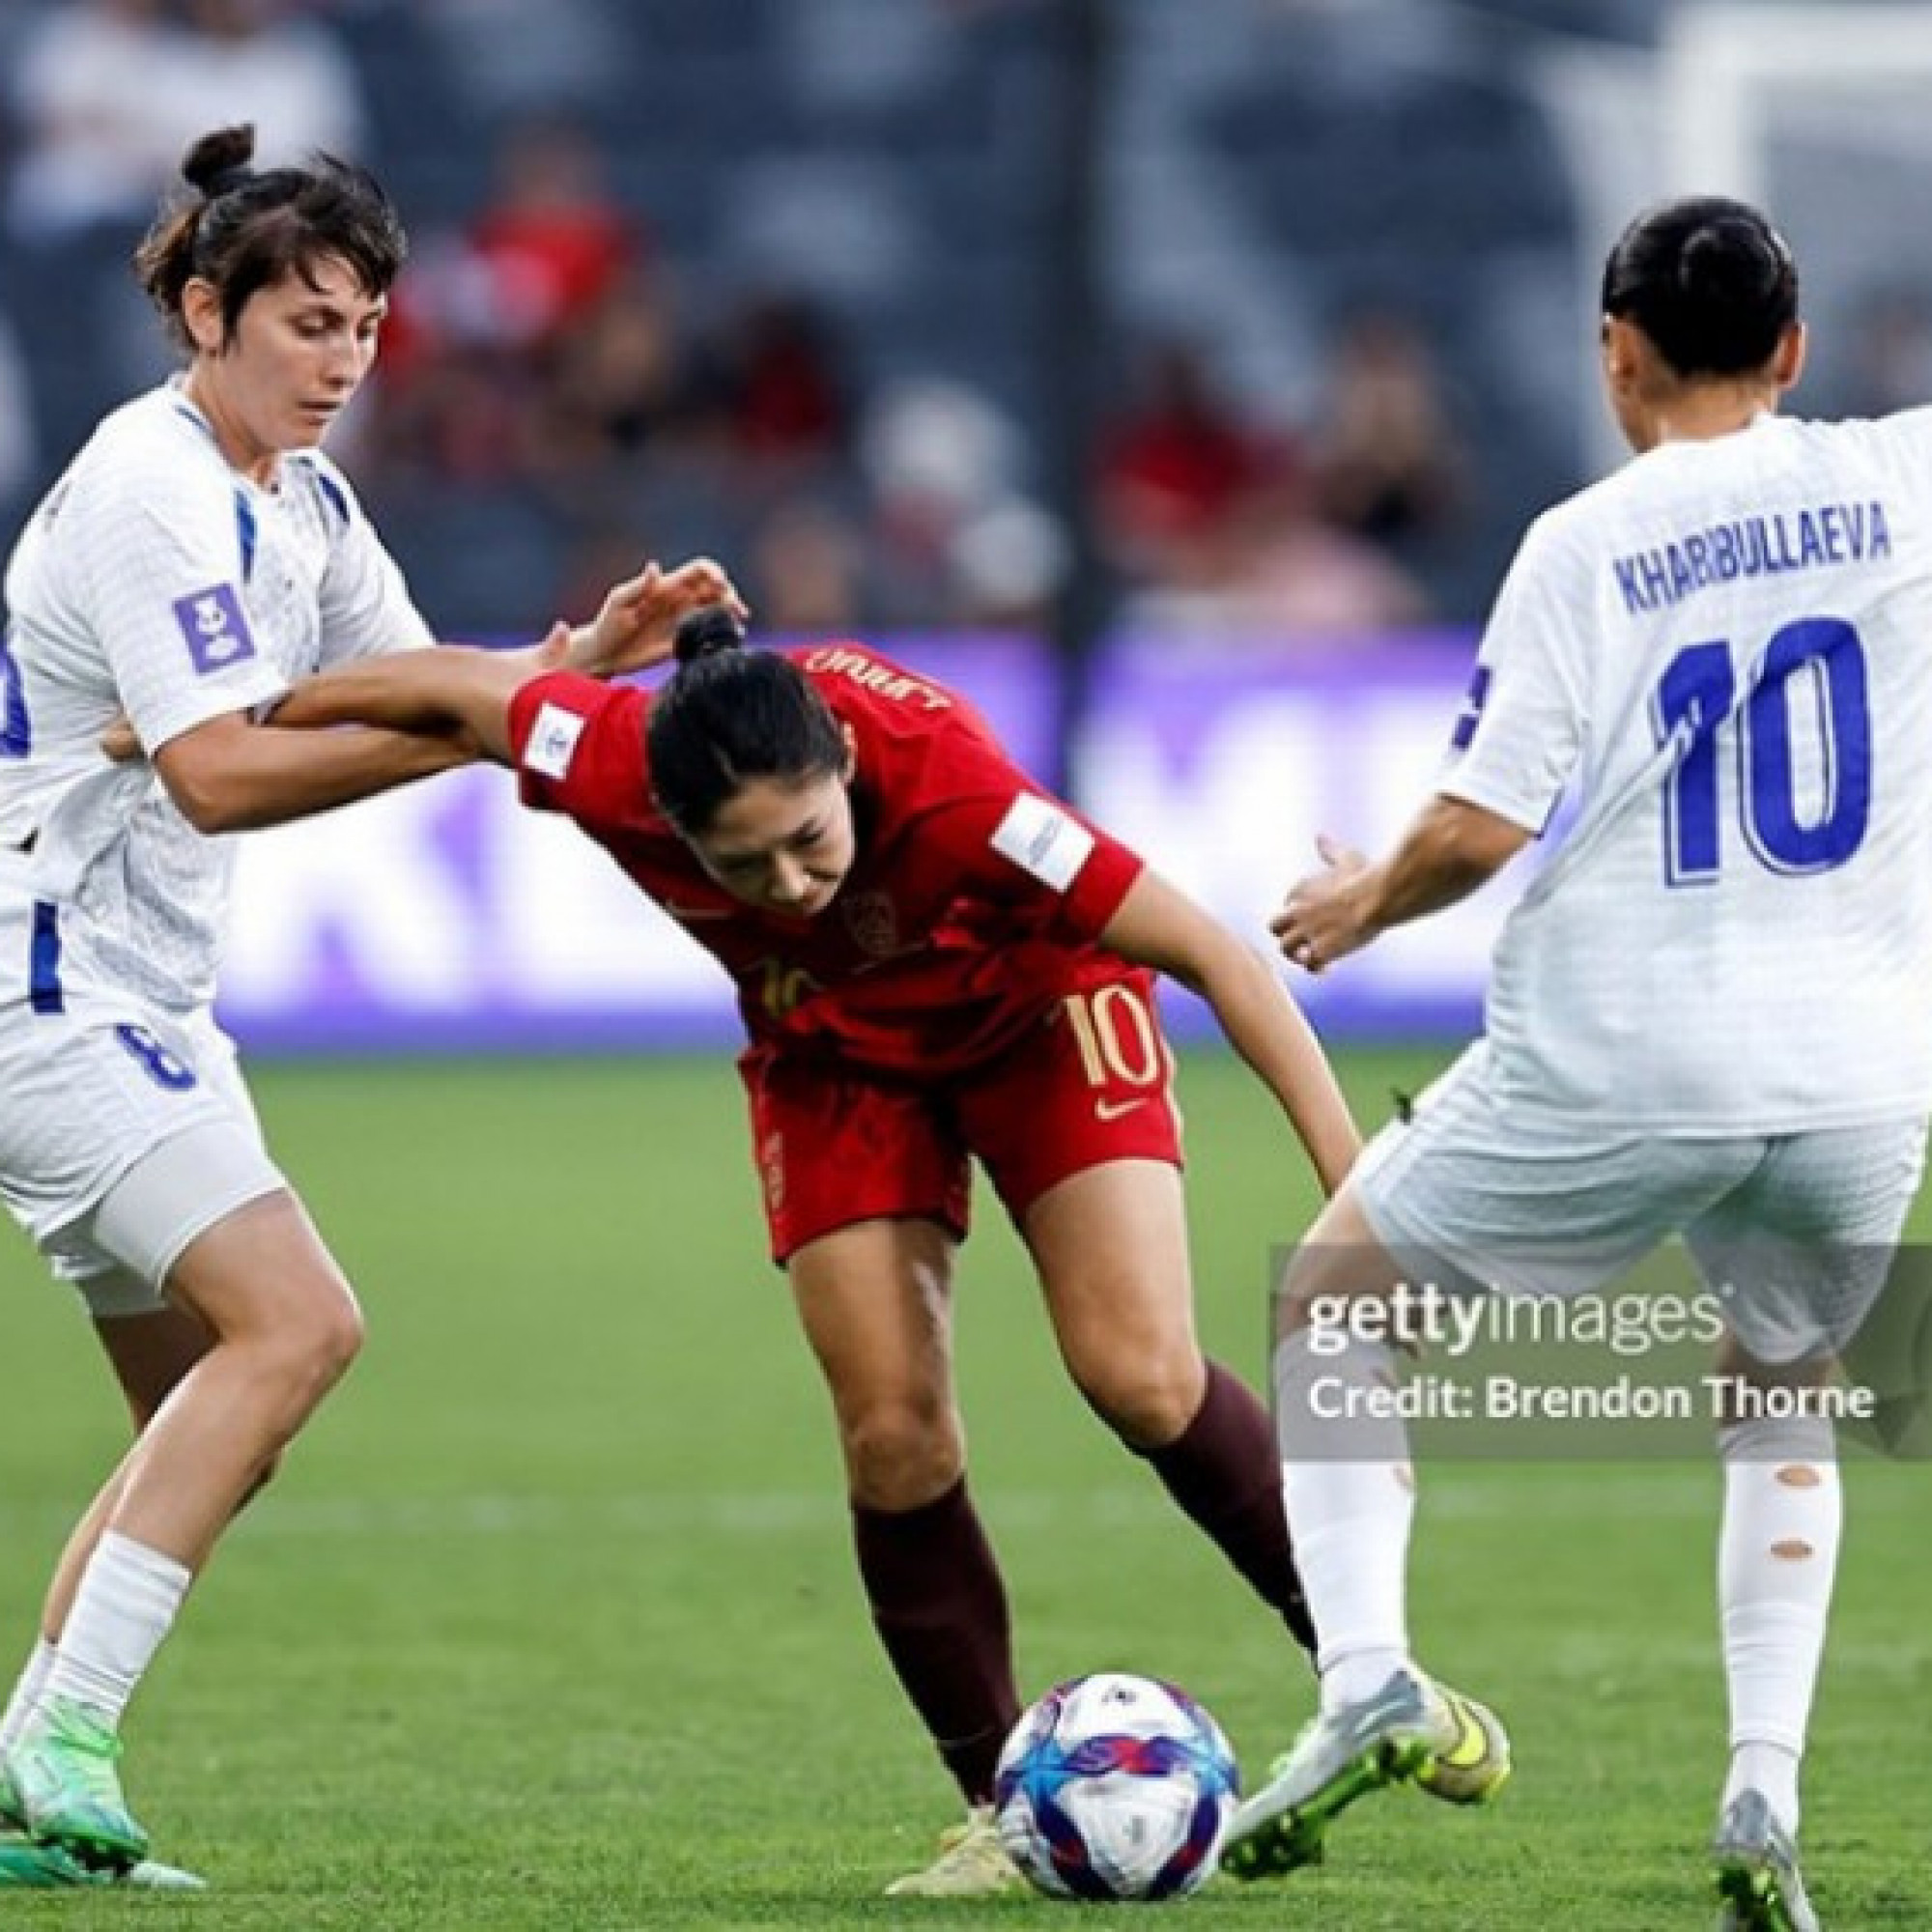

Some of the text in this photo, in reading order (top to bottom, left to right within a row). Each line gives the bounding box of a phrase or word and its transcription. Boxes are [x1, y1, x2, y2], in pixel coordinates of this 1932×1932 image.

[1648, 615, 1872, 888] 10
[115, 1023, 196, 1090] 8
[1064, 984, 1158, 1086] 10
